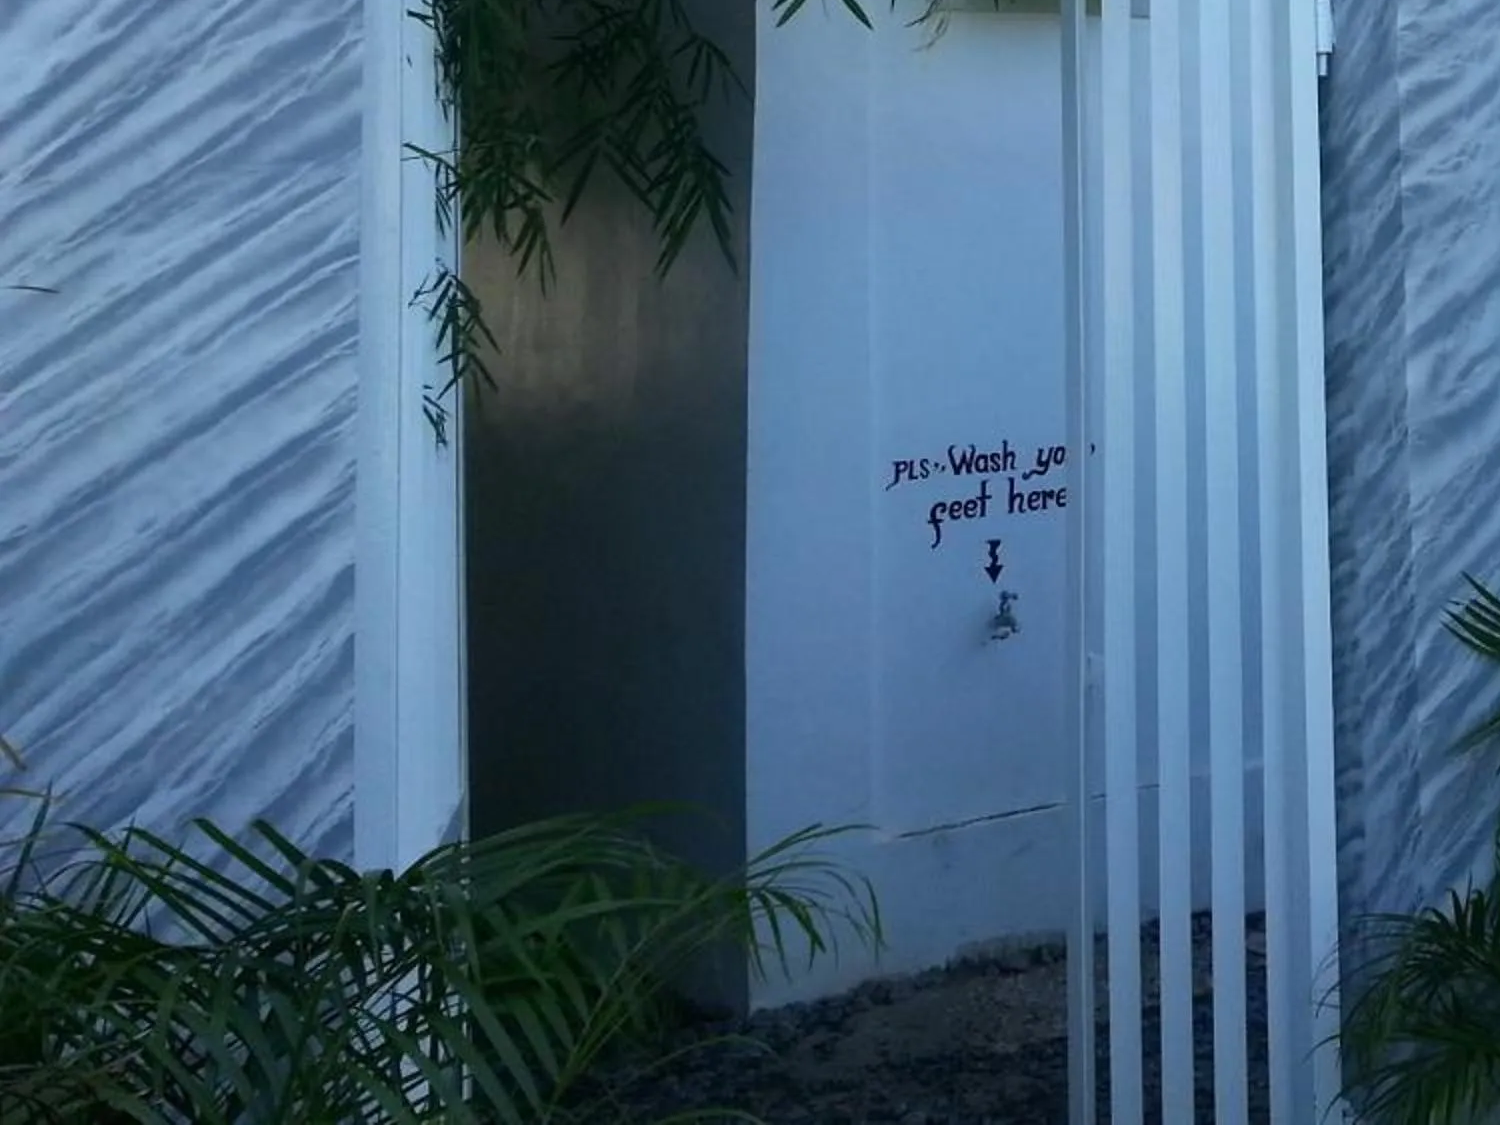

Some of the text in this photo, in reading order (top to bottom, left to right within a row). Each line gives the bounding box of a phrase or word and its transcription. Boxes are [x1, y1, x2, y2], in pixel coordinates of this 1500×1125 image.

[948, 439, 1017, 476] Wash
[927, 477, 1067, 550] feet here
